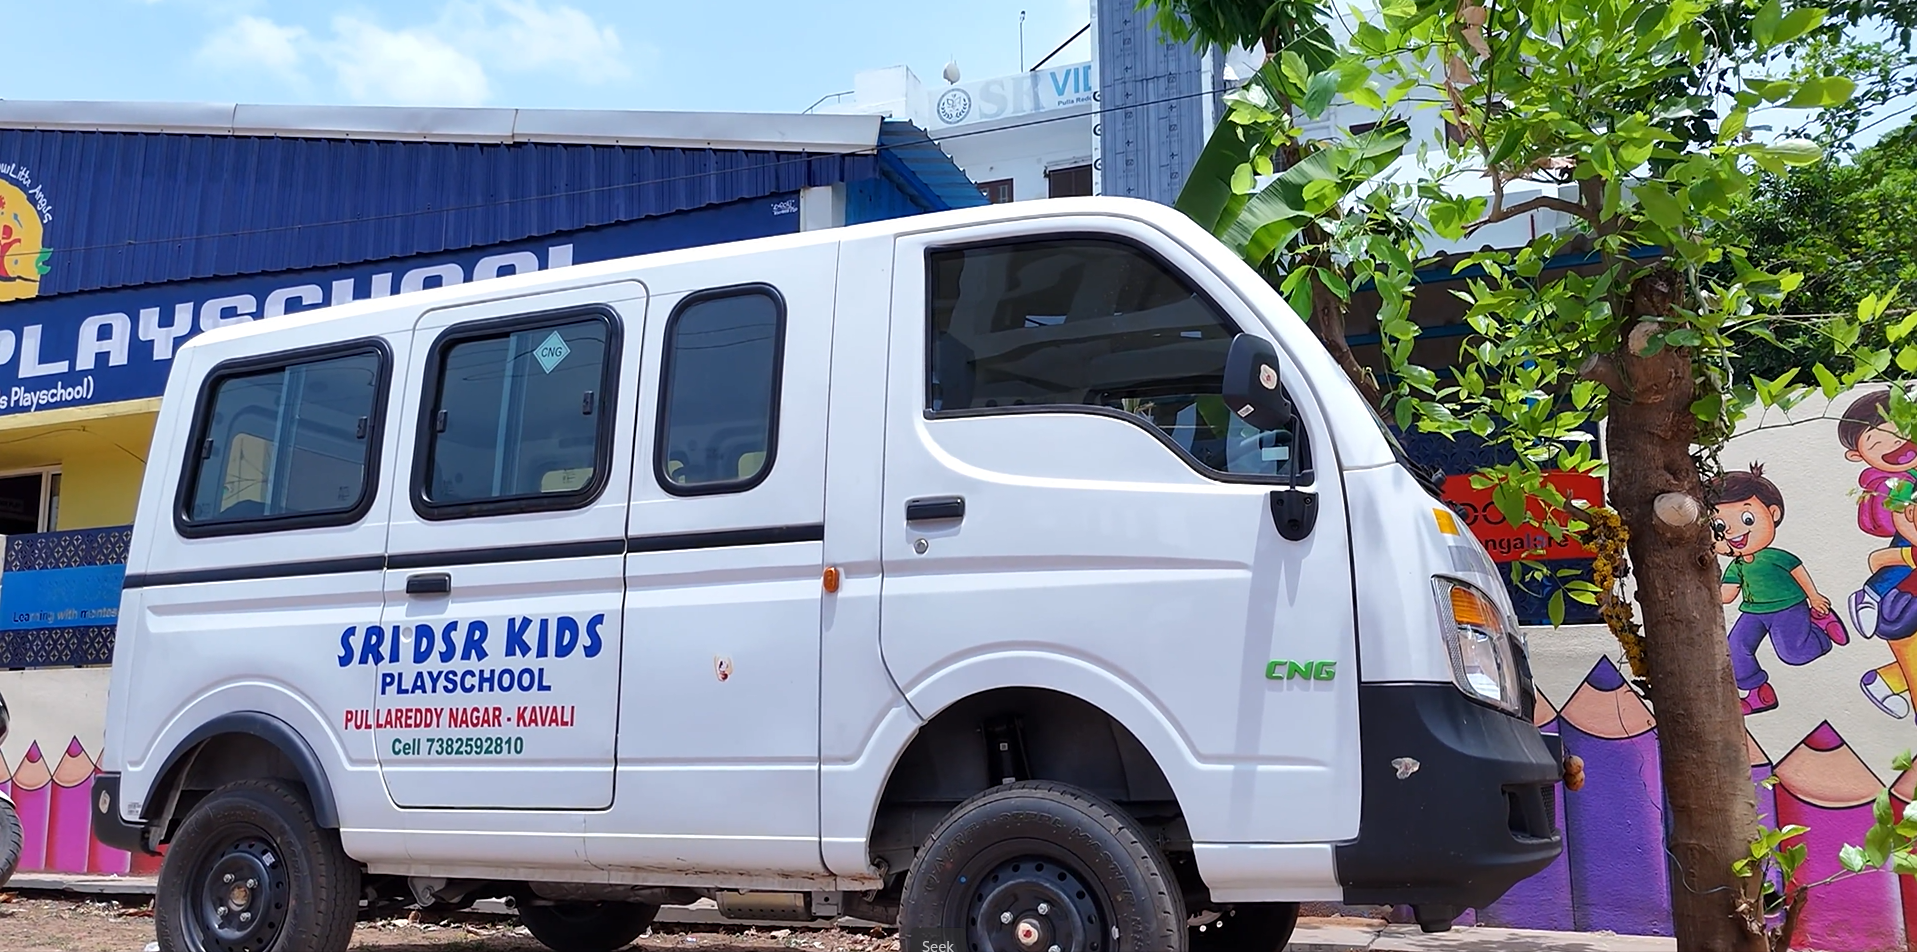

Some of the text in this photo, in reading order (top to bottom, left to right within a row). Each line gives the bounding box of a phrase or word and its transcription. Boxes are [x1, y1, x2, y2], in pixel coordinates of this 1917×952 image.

[541, 346, 563, 358] CNG
[10, 375, 94, 413] Playschool)
[13, 610, 54, 624] Learning
[57, 607, 78, 620] with
[337, 613, 605, 668] SRI DSR KIDS
[380, 667, 552, 696] PLAYSCHOOL
[1265, 659, 1338, 681] CNG
[344, 706, 445, 731] PULLAREDDY
[448, 706, 503, 729] NAGAR
[516, 705, 575, 728] KAVALI
[391, 736, 524, 756] Cell 7382592810
